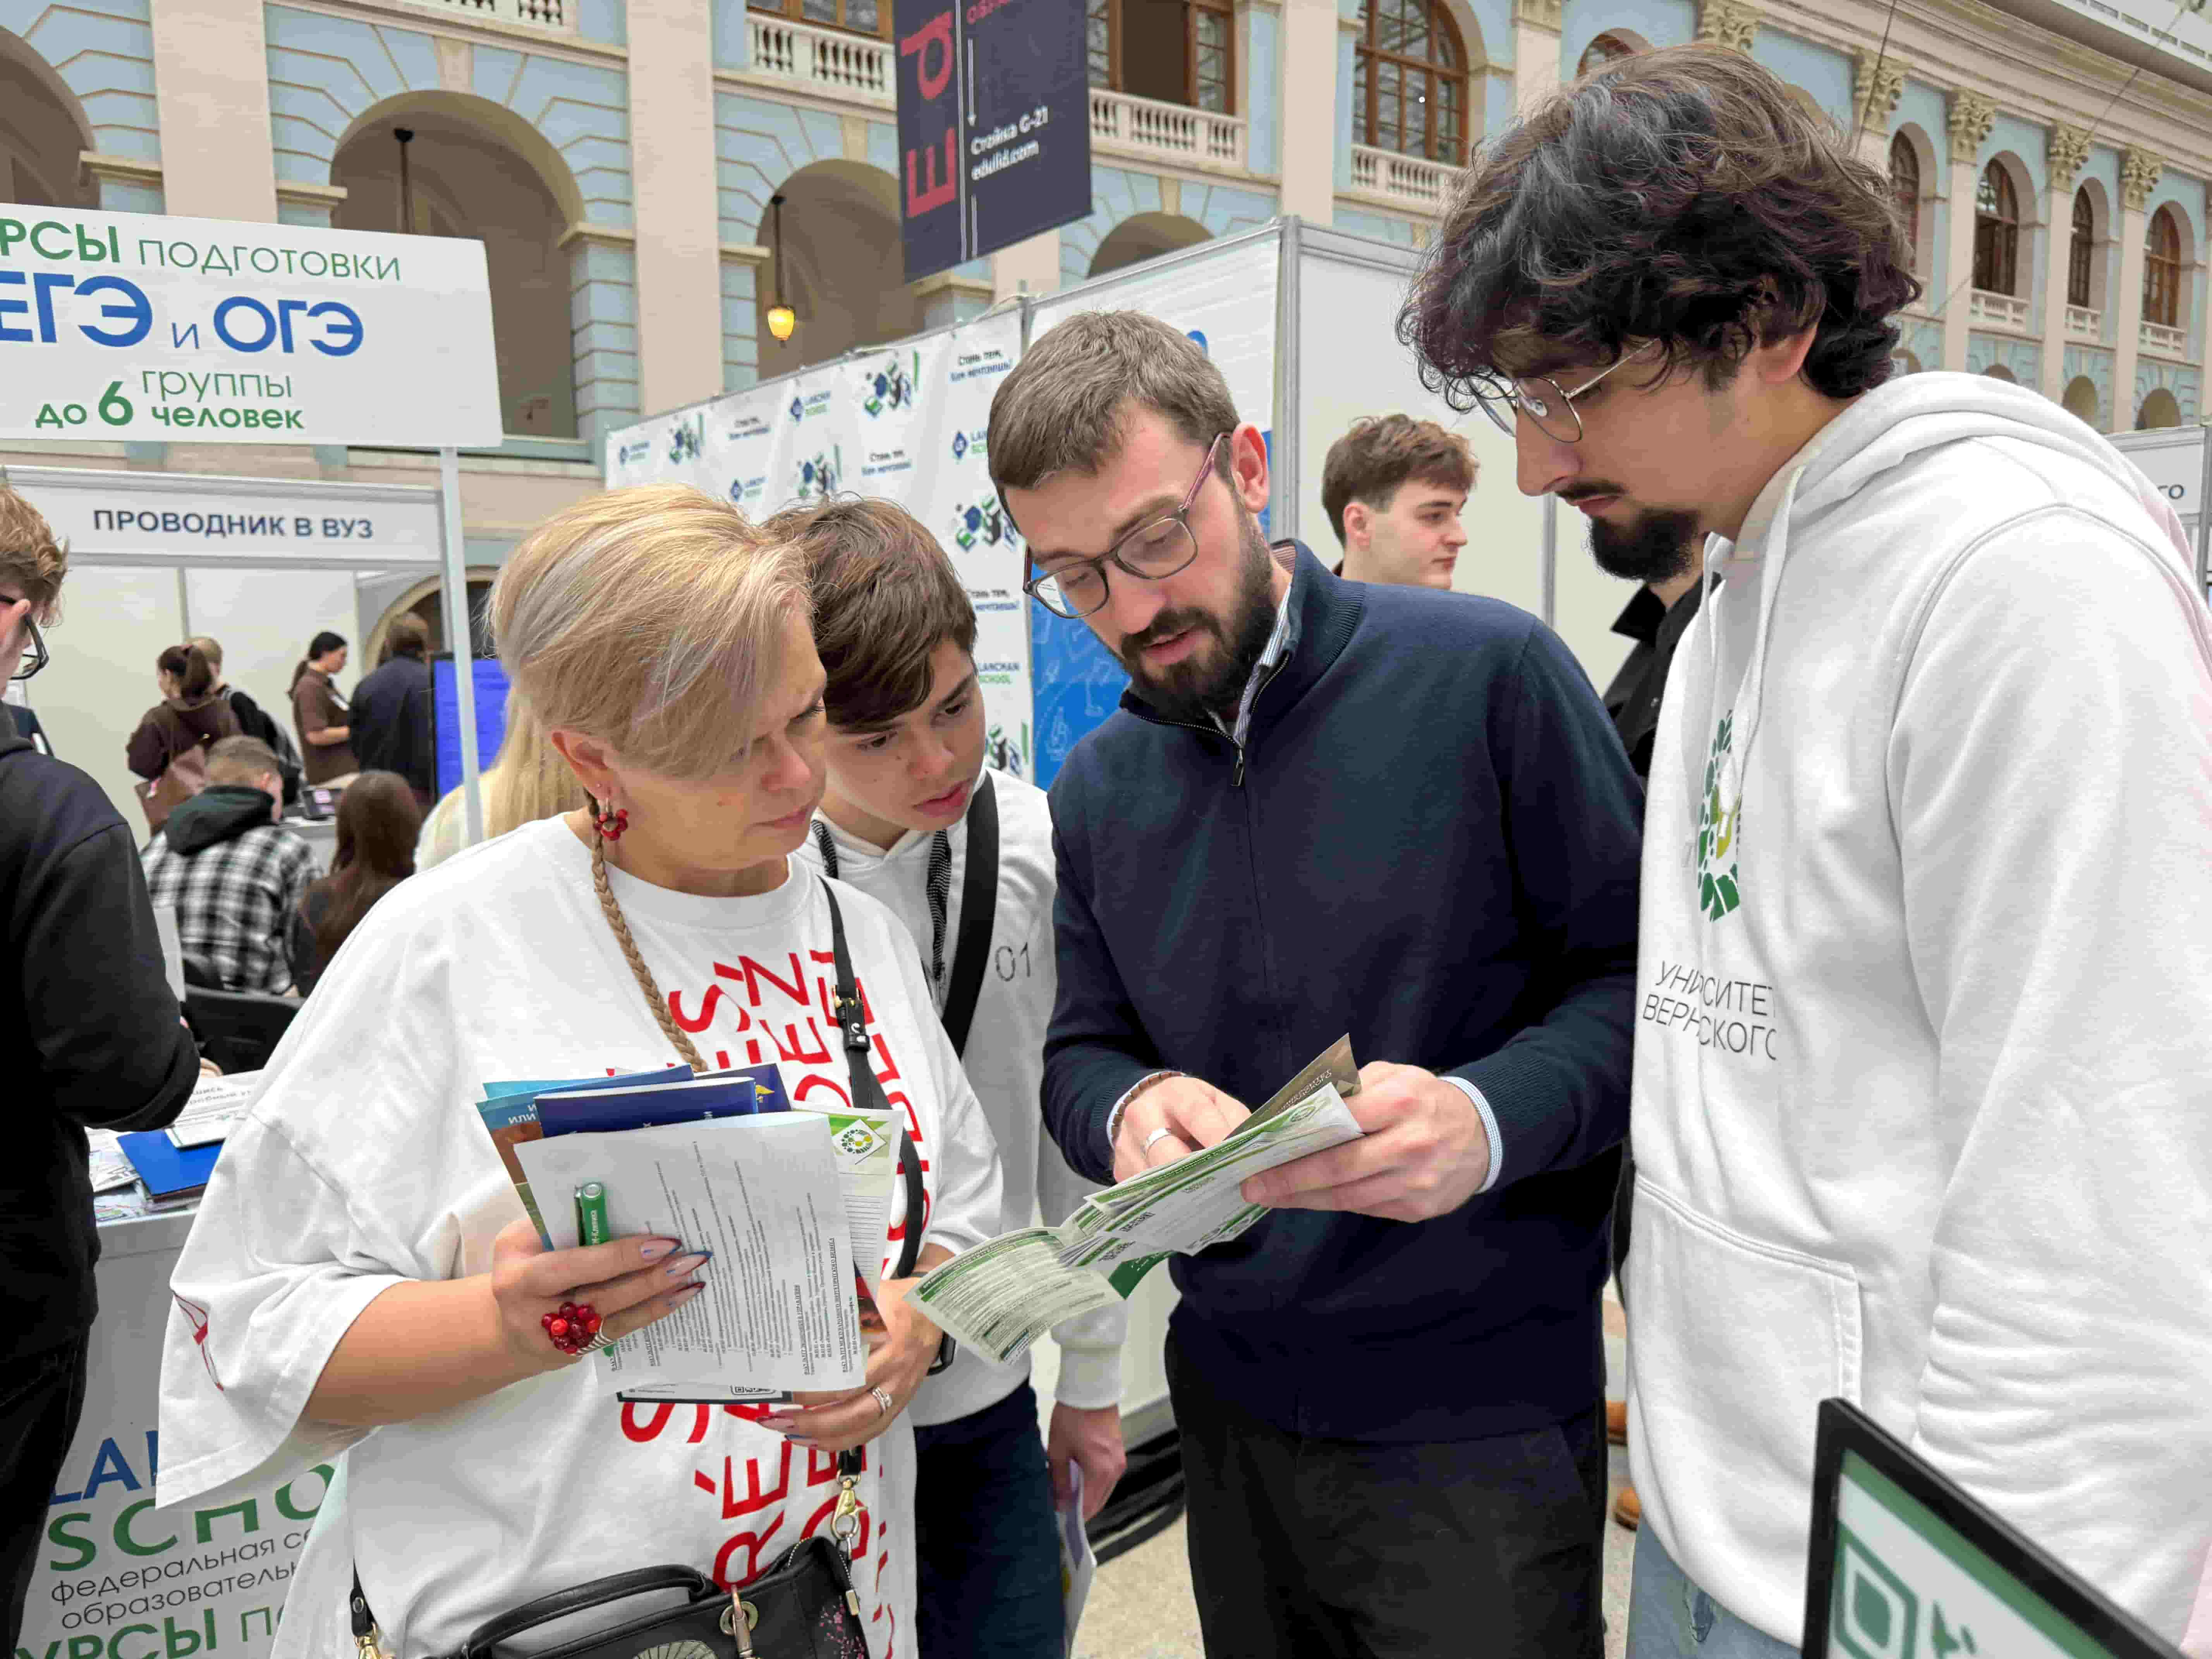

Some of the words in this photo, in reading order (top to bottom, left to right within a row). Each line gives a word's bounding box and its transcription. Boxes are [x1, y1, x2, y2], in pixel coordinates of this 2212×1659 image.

[970, 125, 1018, 155] Стойка
[139, 239, 401, 282] ПОДГОТОВКИ
[0, 271, 153, 347] ЕГЭ
[213, 296, 364, 357] ОГЭ
[35, 403, 88, 429] до
[98, 381, 134, 427] 6
[151, 405, 305, 430] человек
[142, 370, 292, 402] группы
[93, 509, 285, 538] ПРОВОДНИК
[294, 518, 312, 537] В
[323, 518, 373, 539] ВУЗ
[994, 942, 1030, 982] 01
[51, 1539, 275, 1607] федеральная
